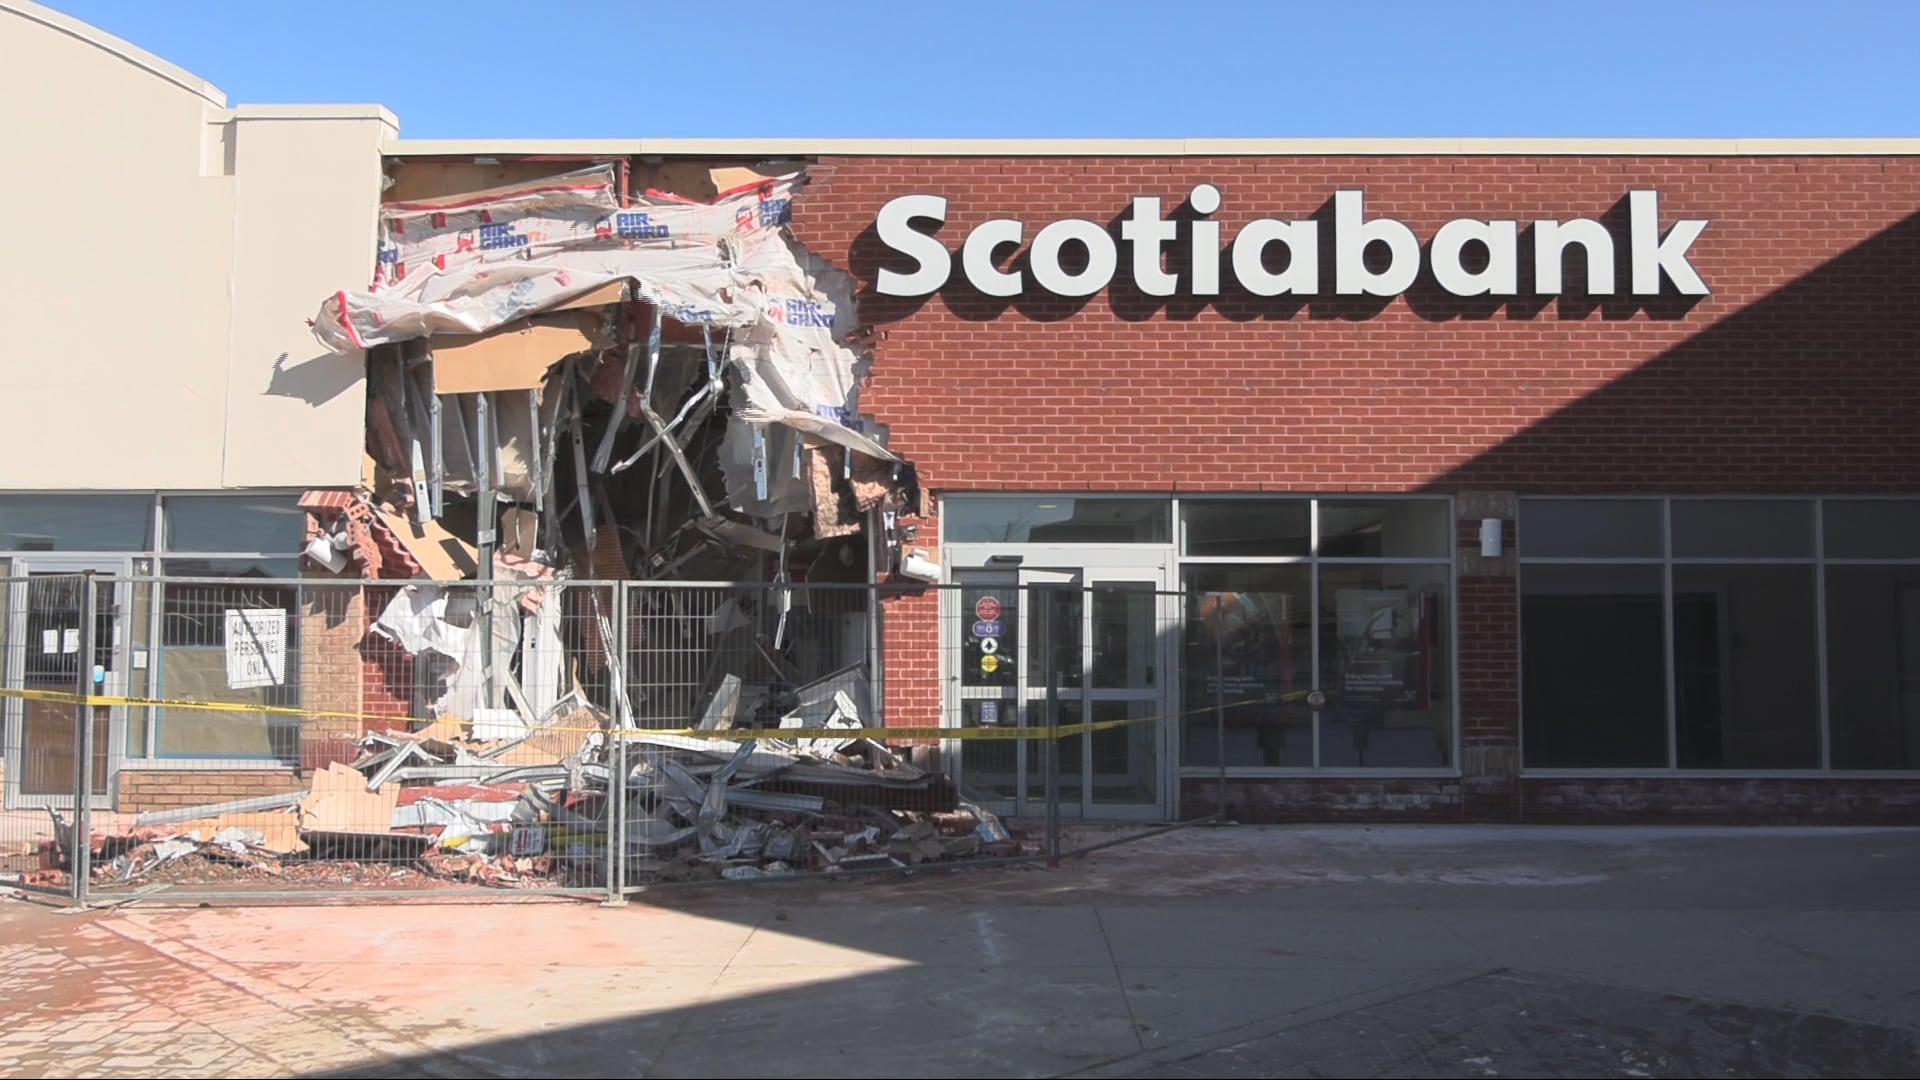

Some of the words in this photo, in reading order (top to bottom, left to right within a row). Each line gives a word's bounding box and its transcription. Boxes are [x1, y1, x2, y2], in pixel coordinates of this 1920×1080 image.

[618, 225, 669, 239] GARD
[480, 234, 528, 250] GARD
[875, 184, 1710, 298] Scotiabank
[234, 639, 279, 656] PERSNEL
